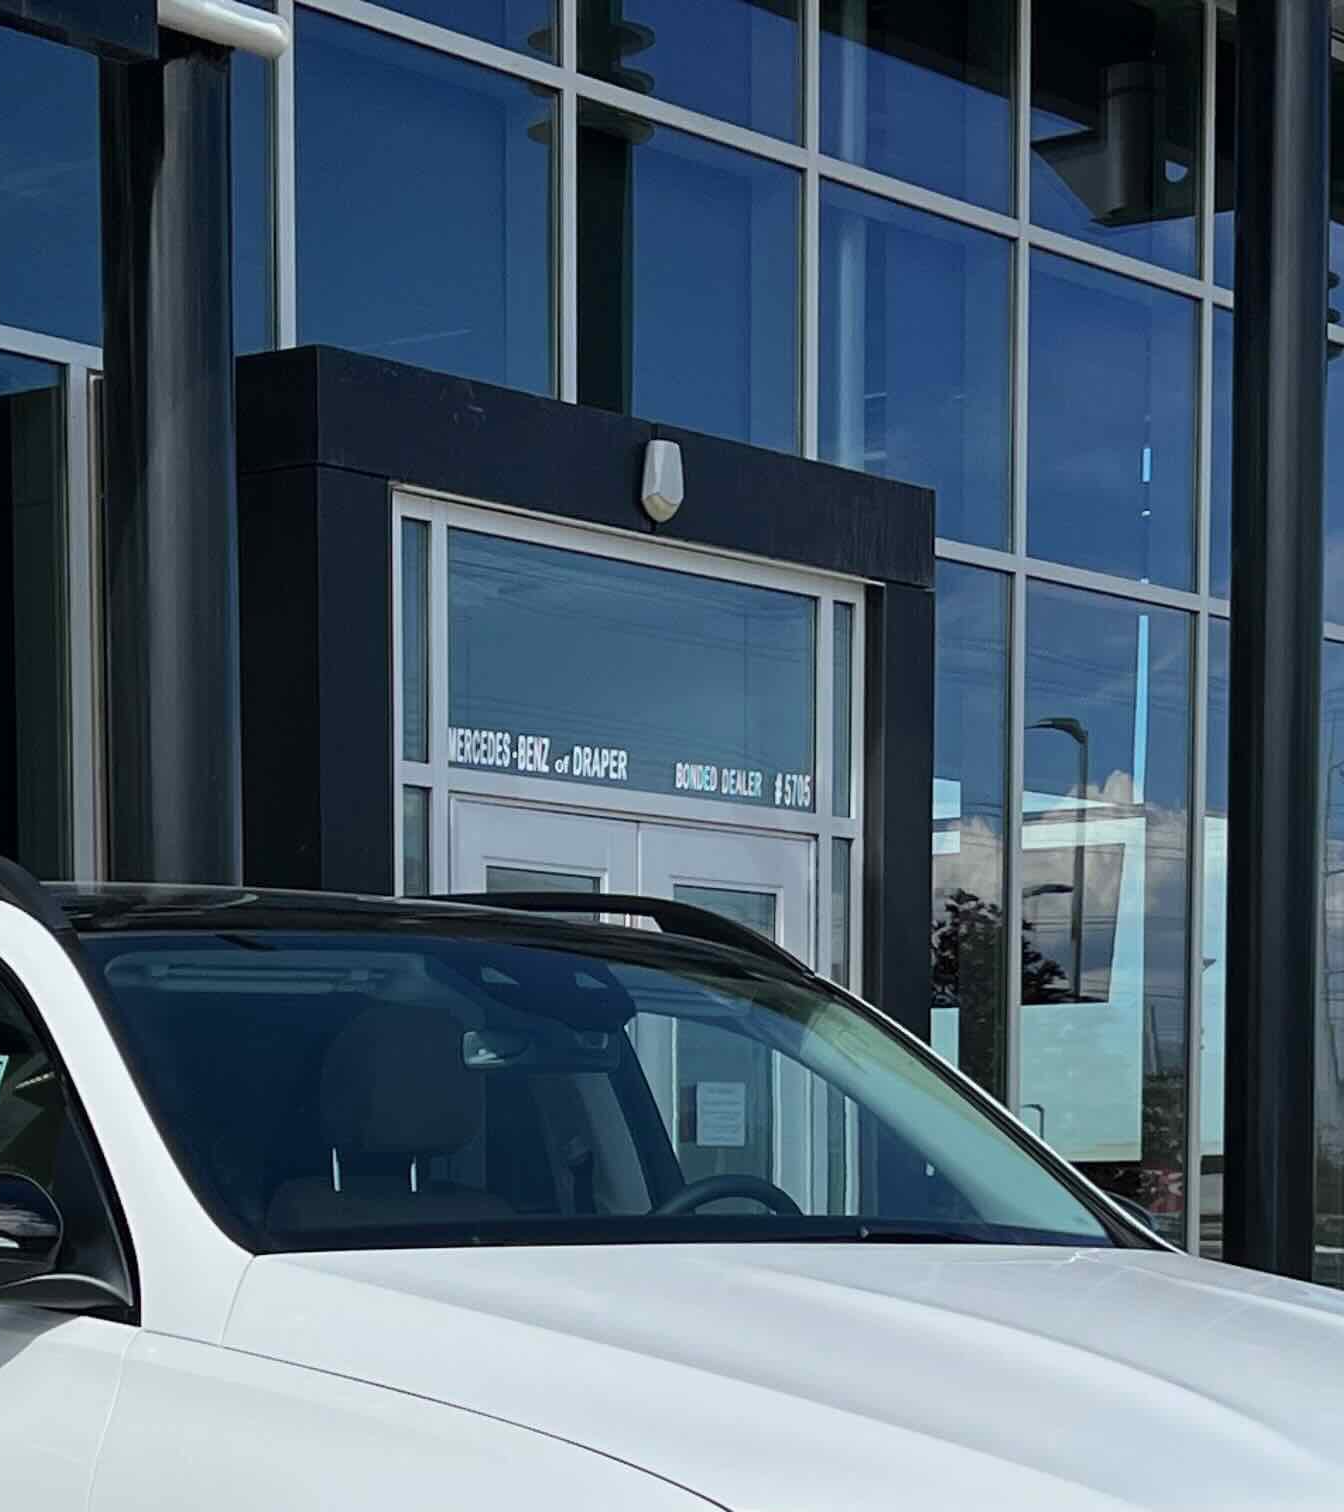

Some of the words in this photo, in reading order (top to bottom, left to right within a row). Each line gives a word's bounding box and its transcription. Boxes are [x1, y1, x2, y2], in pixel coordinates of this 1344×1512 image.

[555, 756, 569, 773] of
[573, 746, 627, 780] DRAPER
[676, 762, 717, 791] BONDED
[721, 768, 762, 797] DEALER
